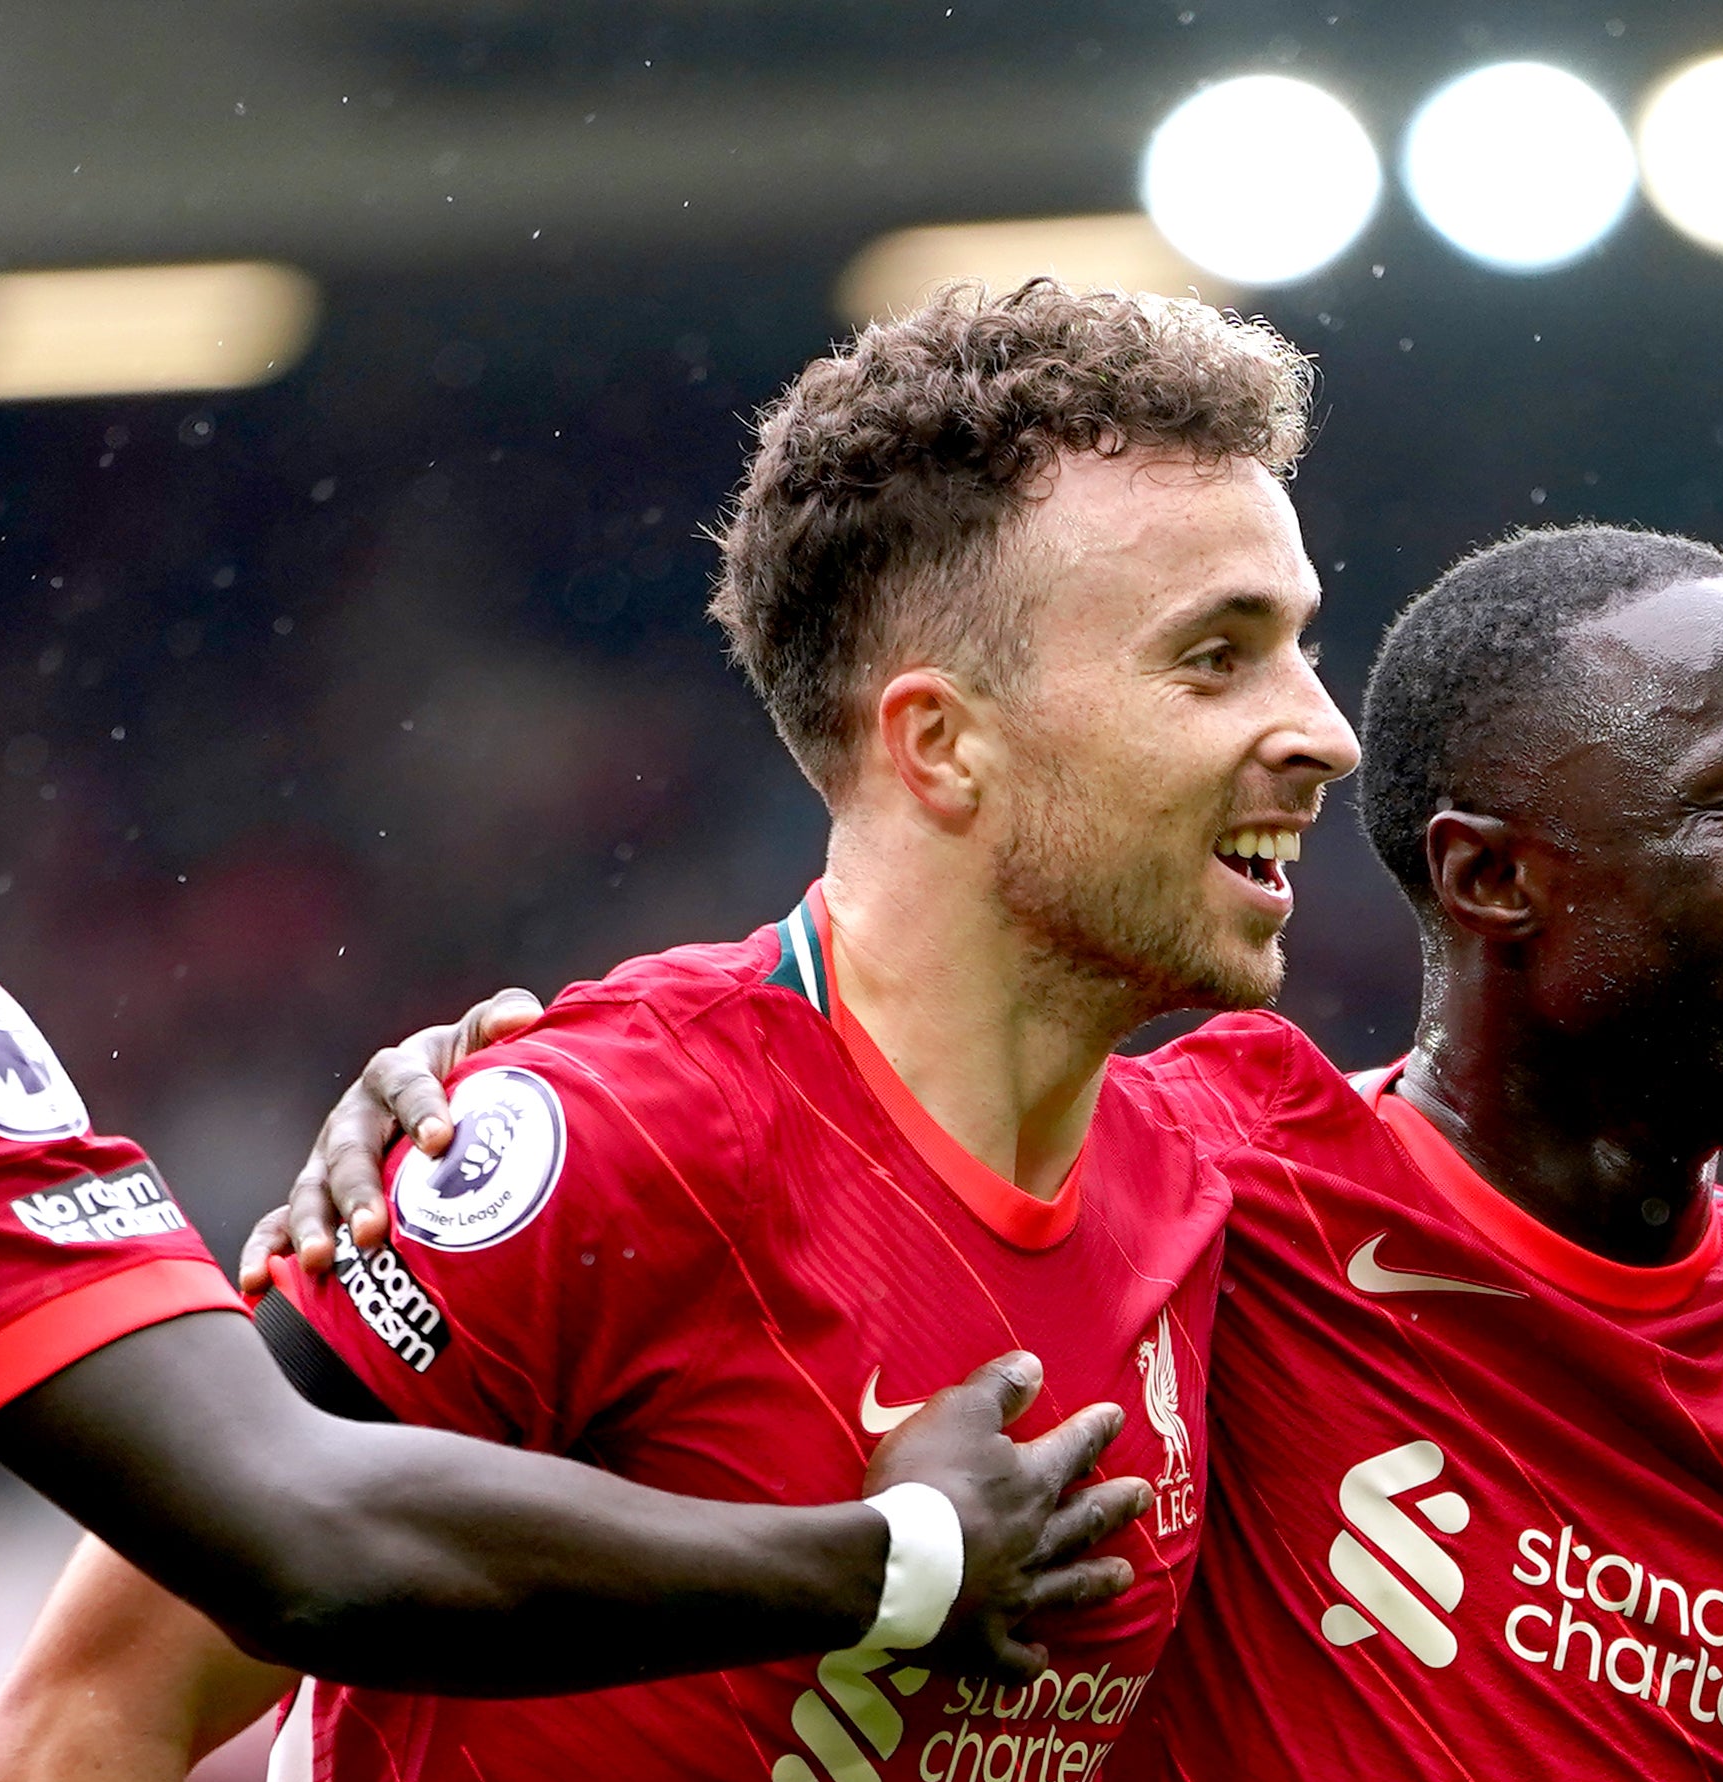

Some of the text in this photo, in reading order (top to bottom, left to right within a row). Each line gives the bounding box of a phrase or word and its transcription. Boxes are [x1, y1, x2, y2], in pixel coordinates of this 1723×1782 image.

[10, 1192, 78, 1228] No
[458, 1189, 513, 1227] League
[339, 1260, 436, 1373] racism
